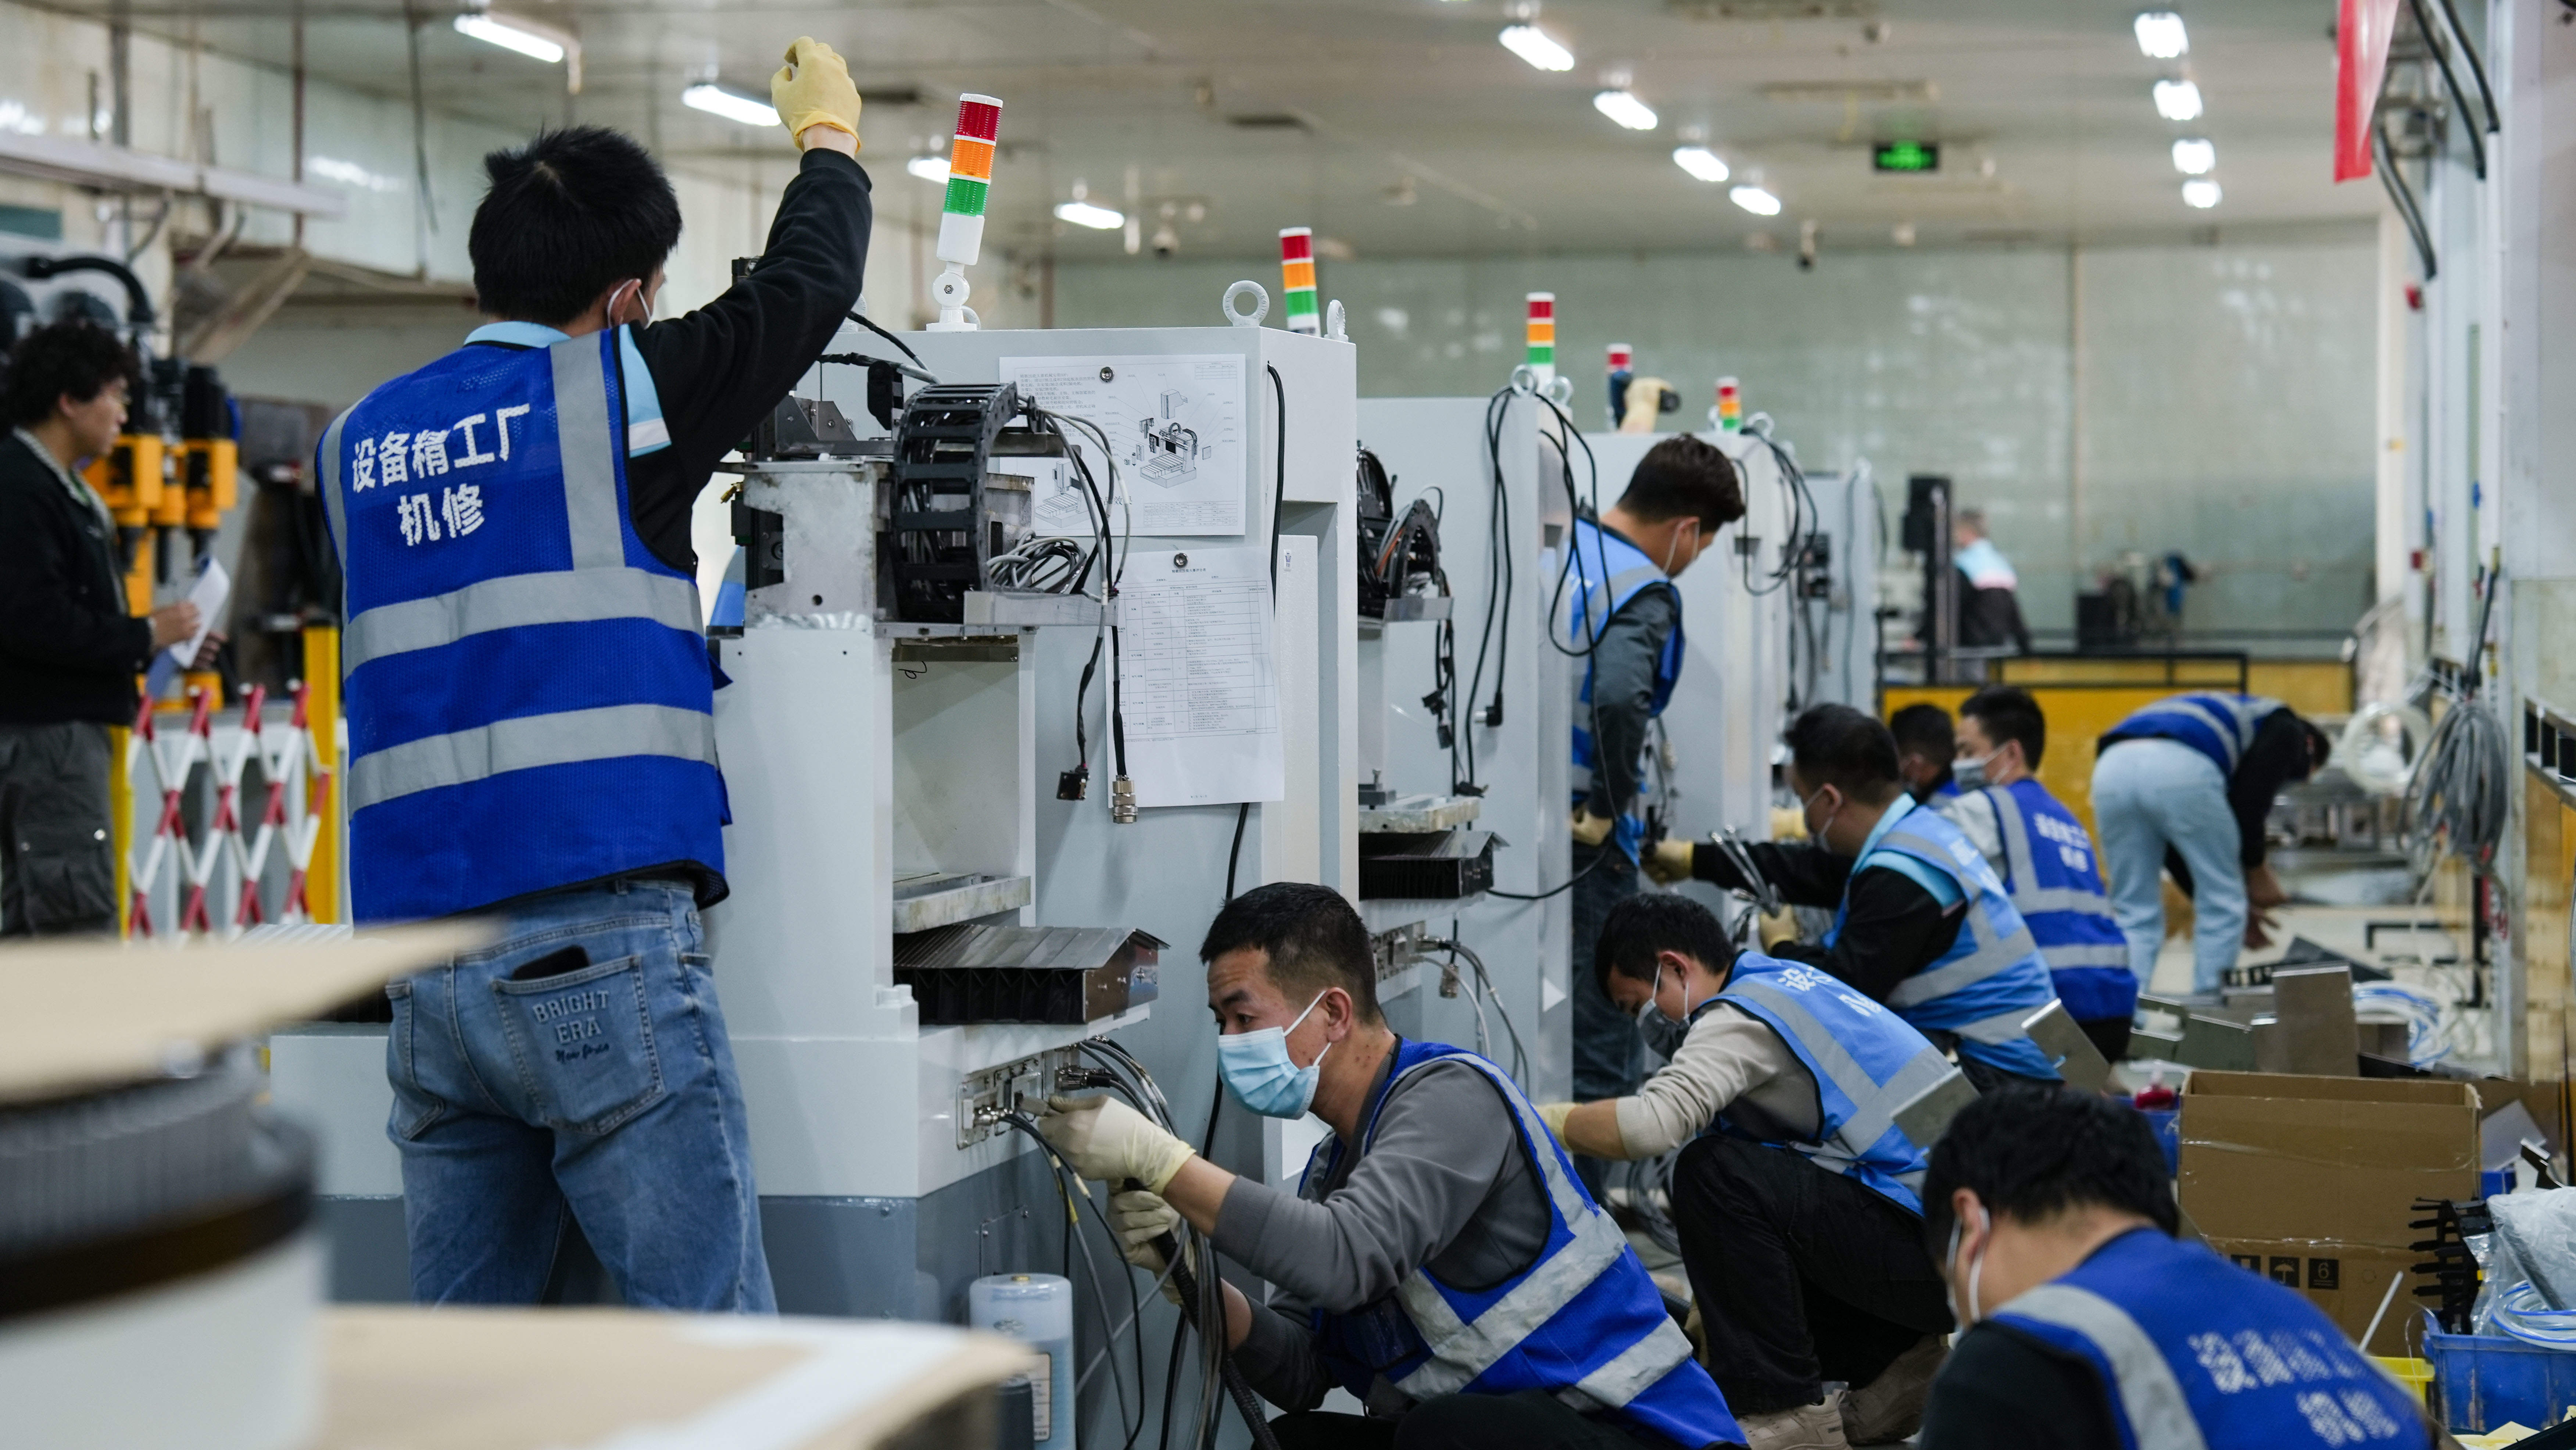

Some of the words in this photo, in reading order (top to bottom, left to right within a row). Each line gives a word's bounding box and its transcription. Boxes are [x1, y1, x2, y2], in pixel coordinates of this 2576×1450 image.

[352, 403, 530, 493] 设备精工厂
[397, 483, 485, 546] 机修
[532, 990, 609, 1023] BRIGHT
[555, 1016, 602, 1044] ERA
[2318, 1262, 2329, 1279] 6
